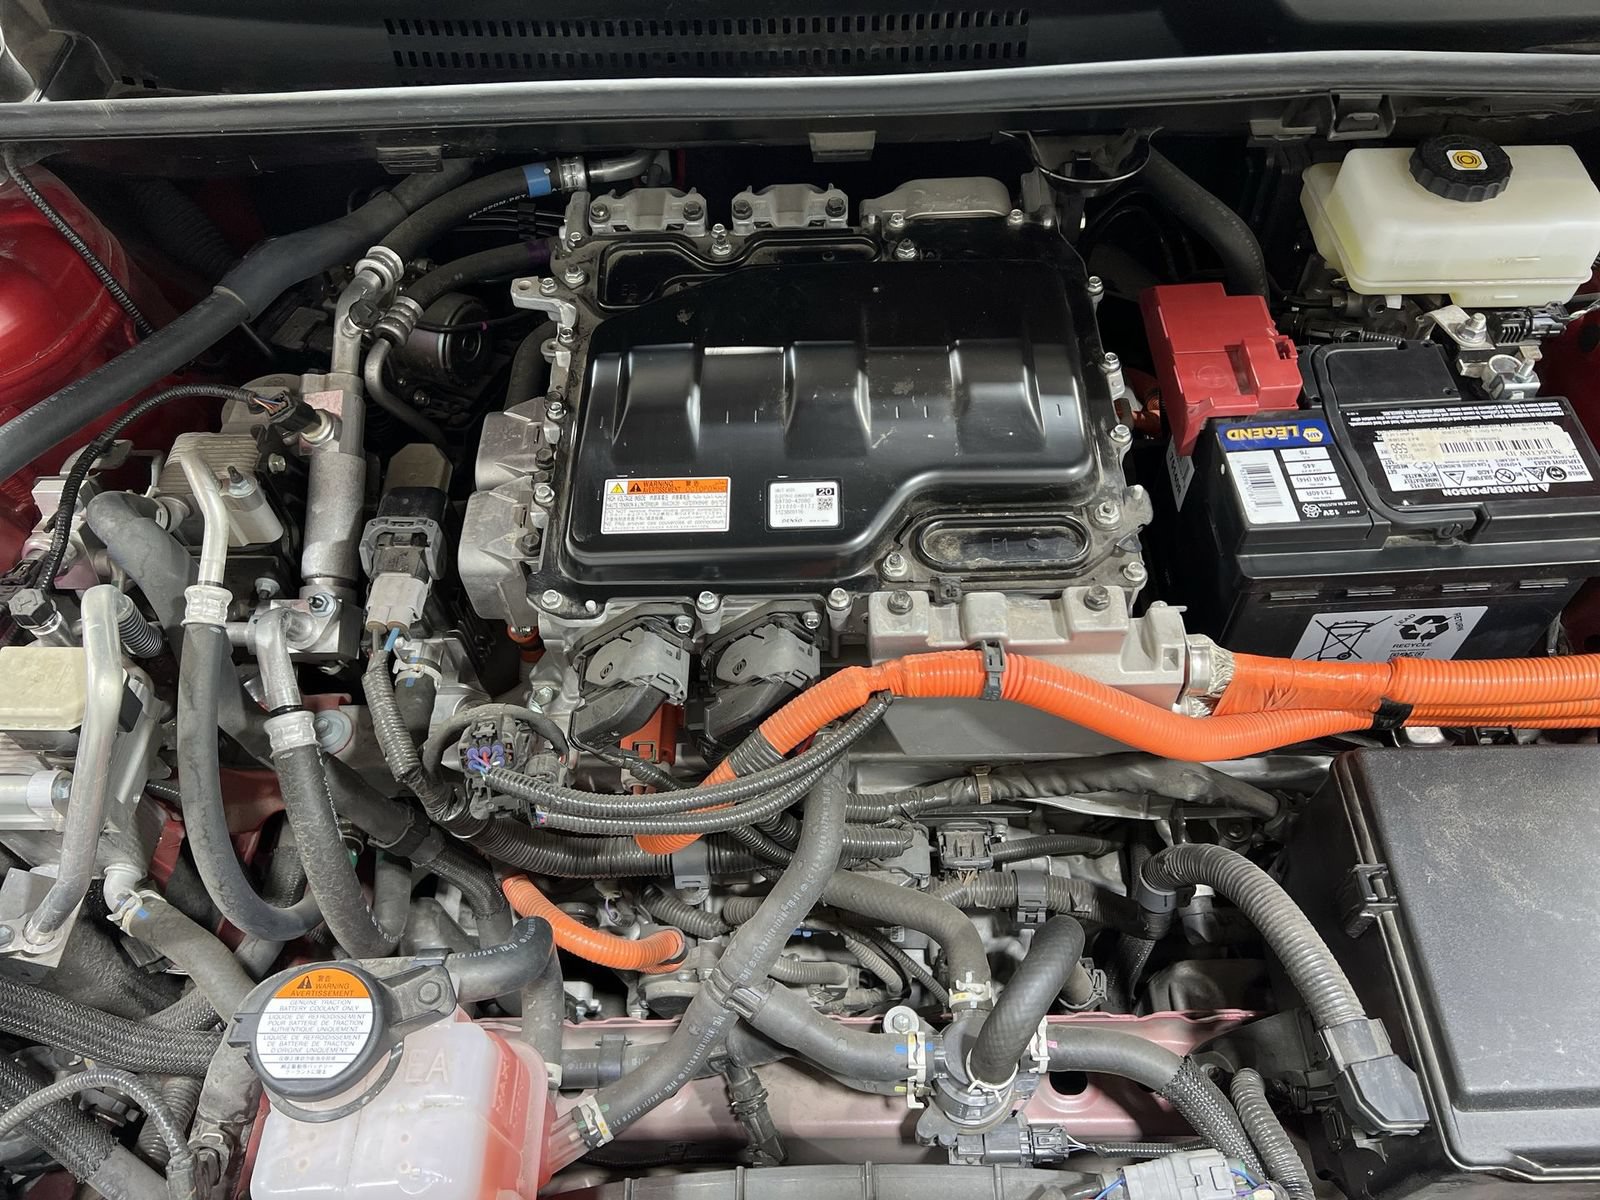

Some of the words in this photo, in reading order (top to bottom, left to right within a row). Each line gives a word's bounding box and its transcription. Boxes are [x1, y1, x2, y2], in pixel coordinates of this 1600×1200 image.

[1226, 425, 1299, 441] LEGEND
[1390, 442, 1409, 454] 558
[643, 480, 675, 488] WARNING
[818, 488, 833, 496] 20
[1305, 489, 1334, 497] 75140R
[1393, 613, 1416, 627] LEAD
[290, 990, 355, 998] AVERTISSEMENT
